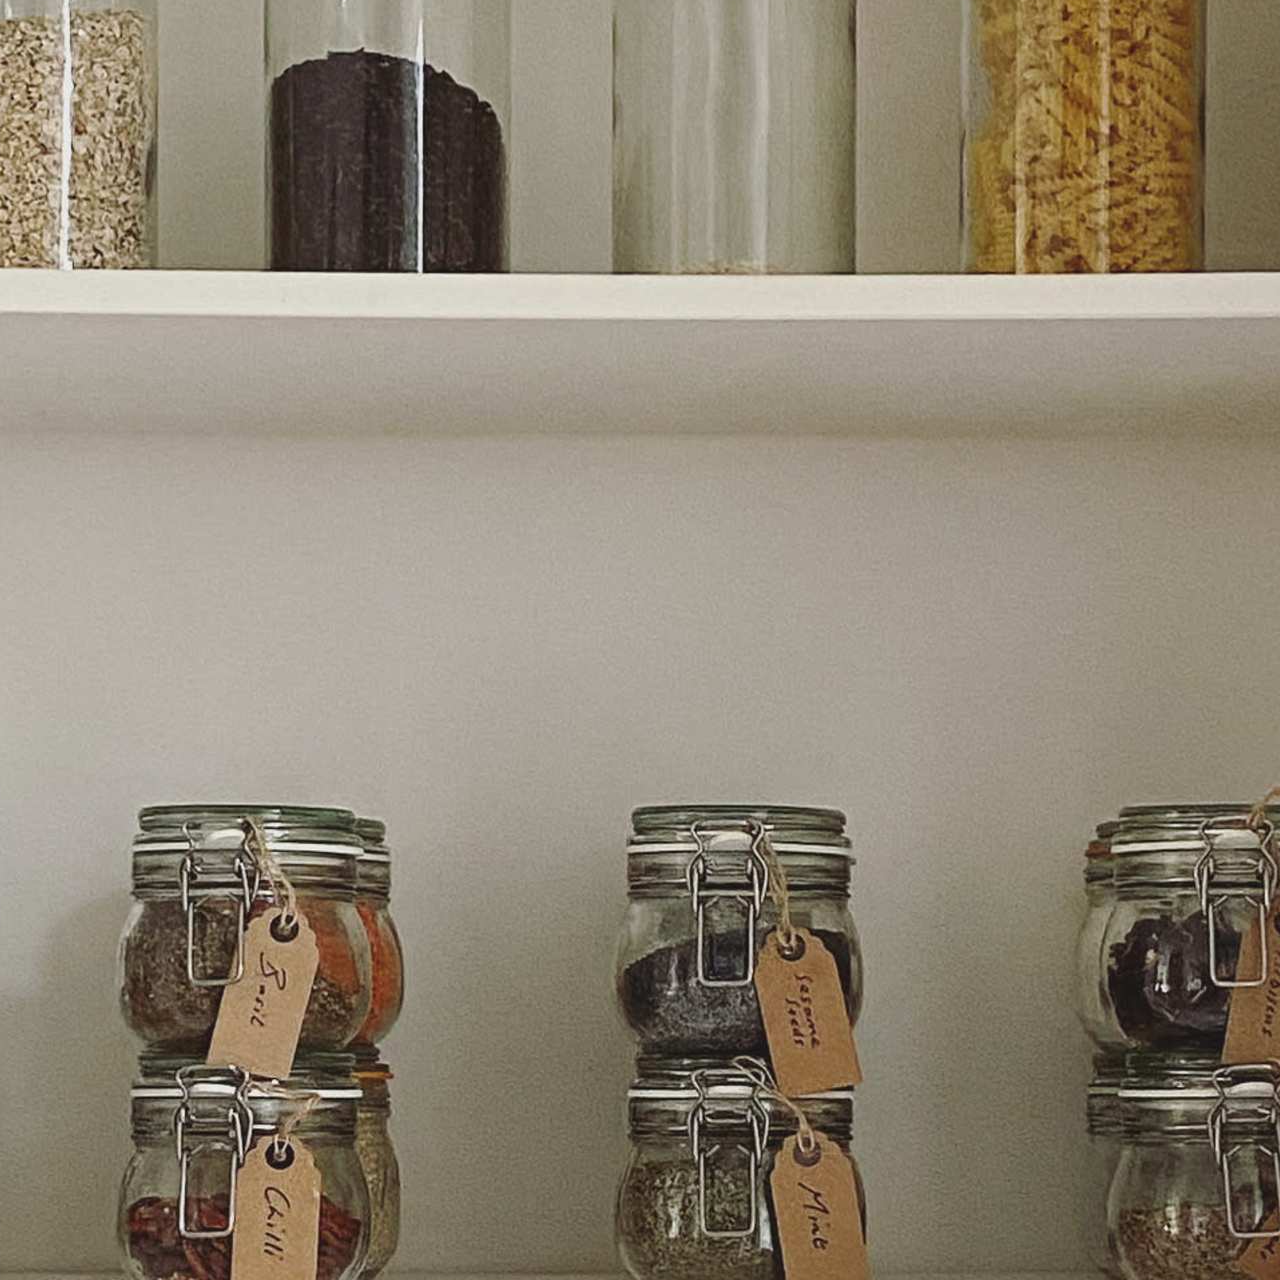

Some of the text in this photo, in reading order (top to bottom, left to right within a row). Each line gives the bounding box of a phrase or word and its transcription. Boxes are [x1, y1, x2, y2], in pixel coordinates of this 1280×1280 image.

[251, 951, 288, 1028] Basil
[795, 974, 821, 1050] Sesame
[263, 1185, 293, 1262] Chilli
[797, 1181, 830, 1250] Mint
